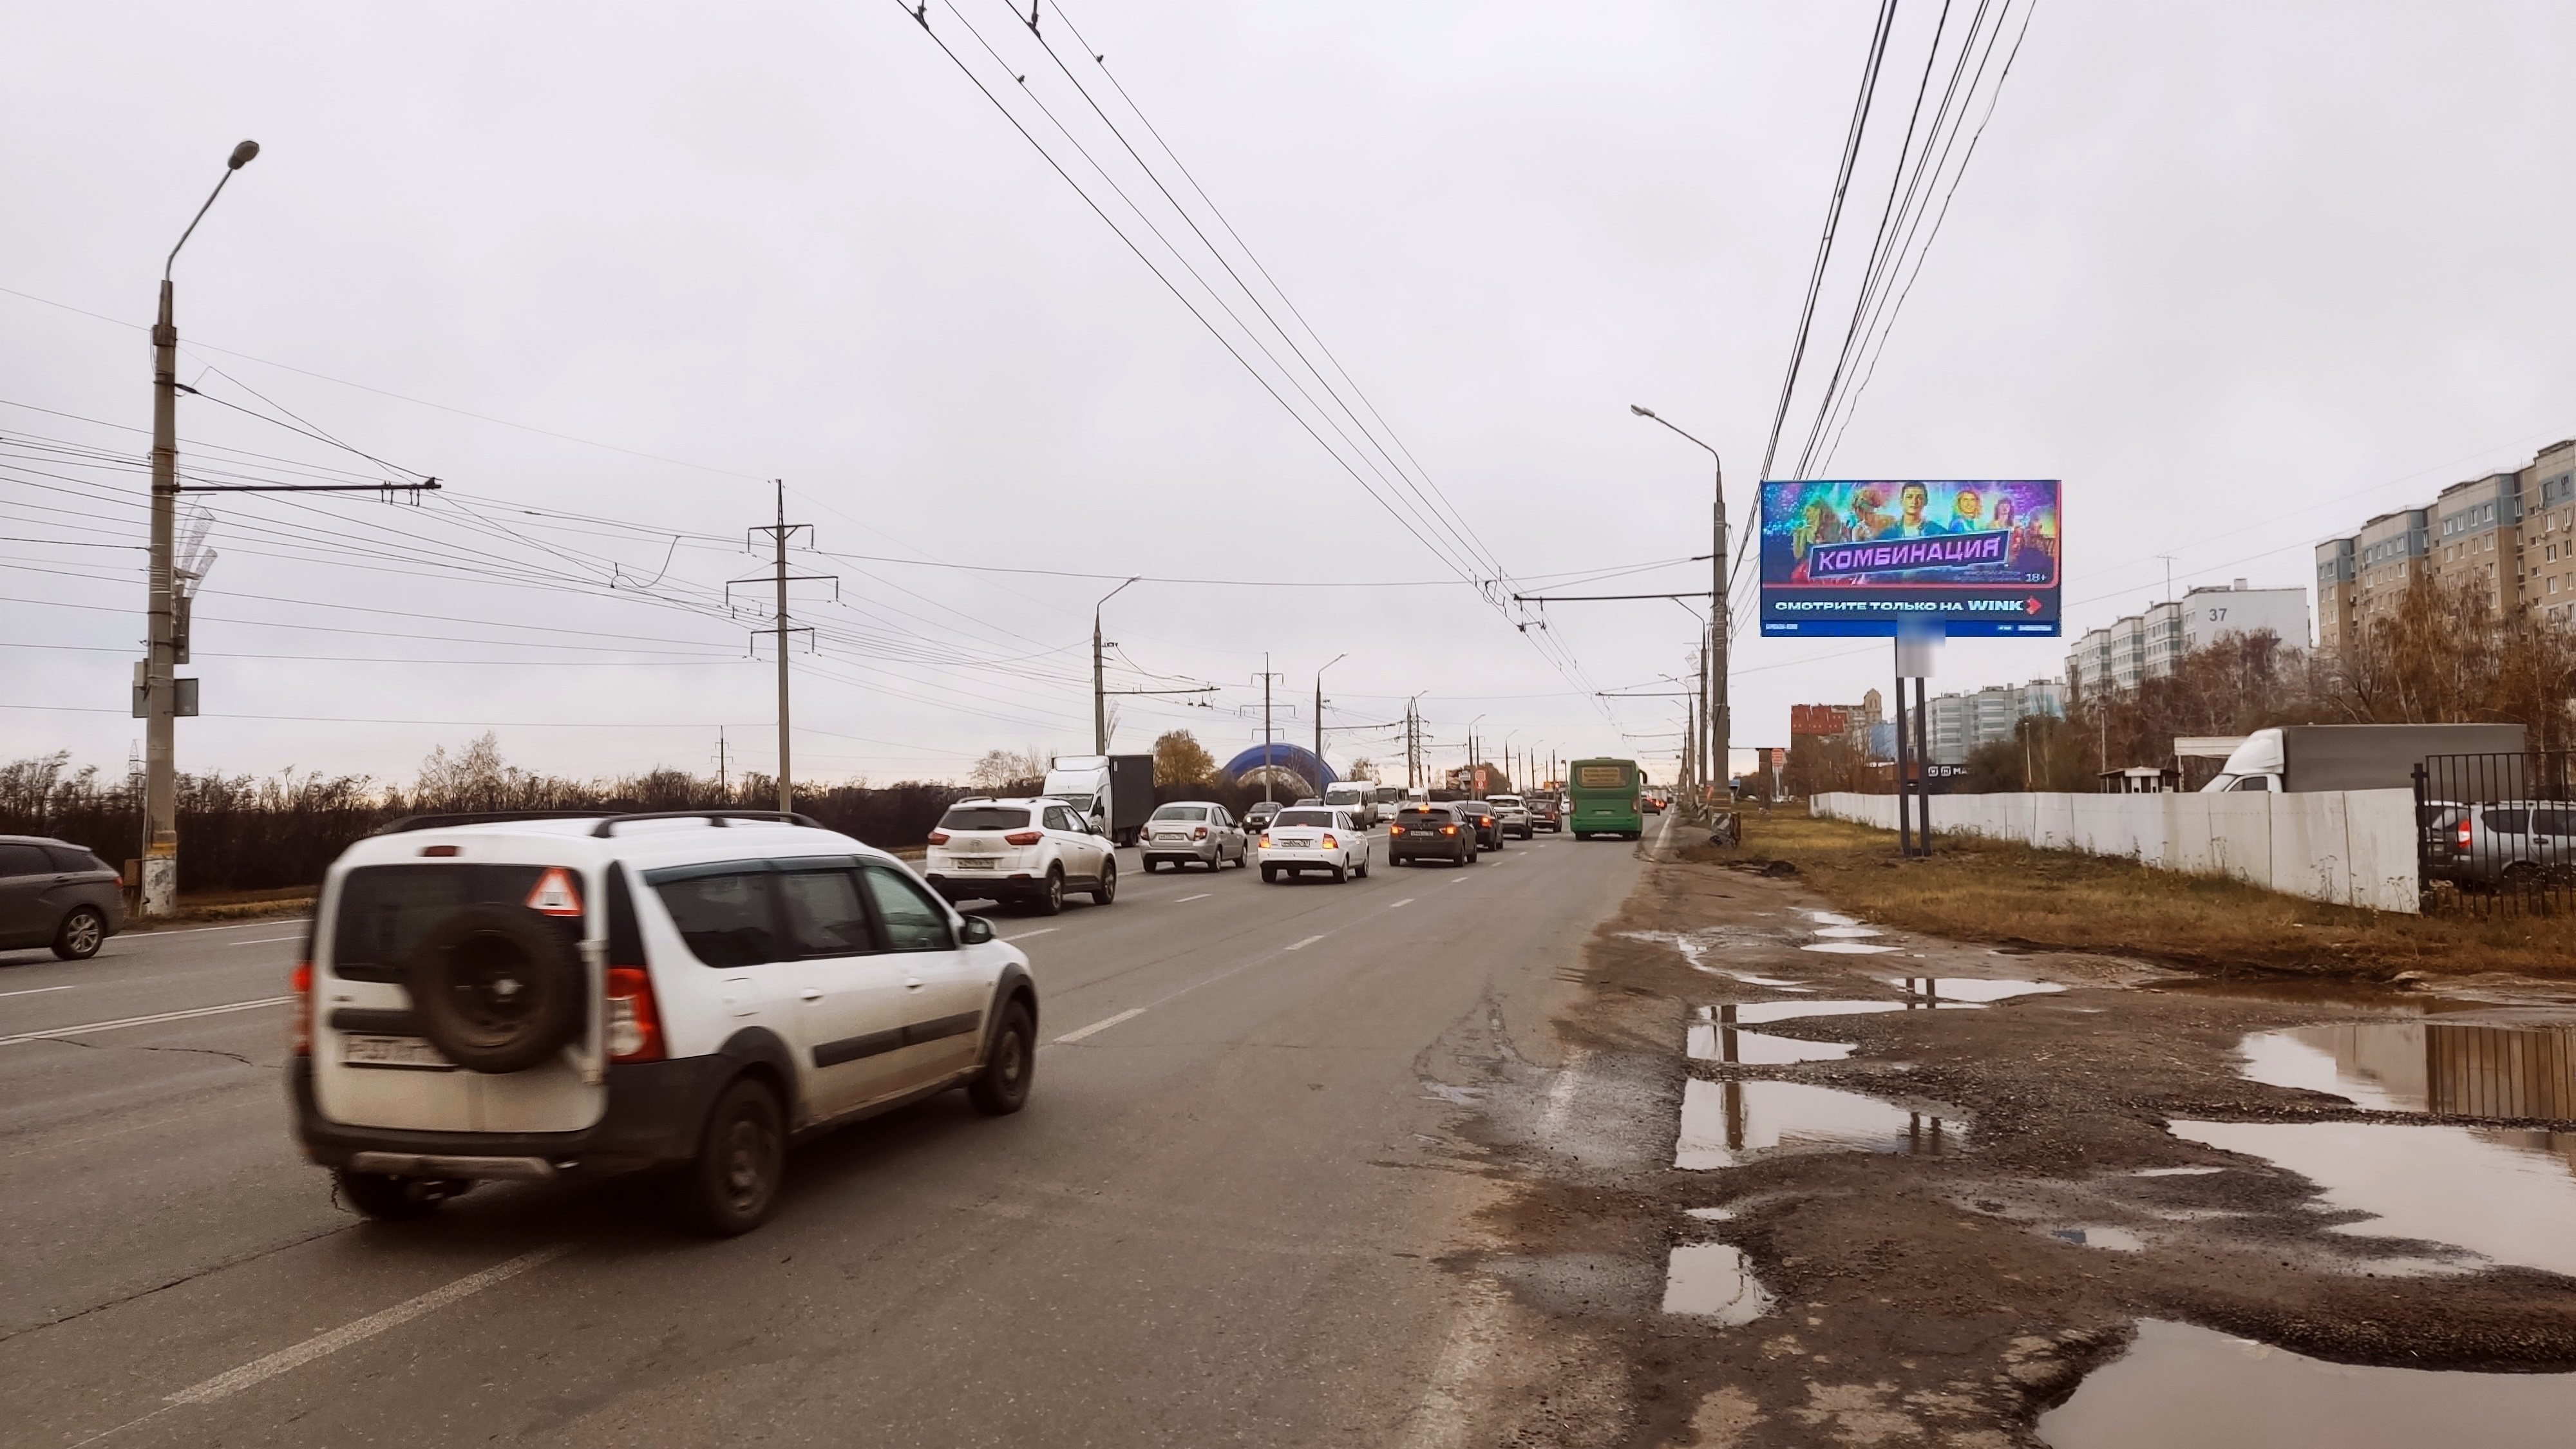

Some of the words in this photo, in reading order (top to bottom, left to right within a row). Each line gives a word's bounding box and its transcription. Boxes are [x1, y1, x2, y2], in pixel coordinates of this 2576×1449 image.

[1819, 536, 2000, 571] КОМБИНАЦИЯ
[2026, 573, 2047, 582] 18+
[1776, 602, 1867, 611] СМОТРИТЕ
[1870, 602, 1937, 611] ТОЛЬКО
[1940, 602, 1963, 611] НА
[1968, 601, 2023, 611] WINK
[2210, 608, 2227, 621] 37
